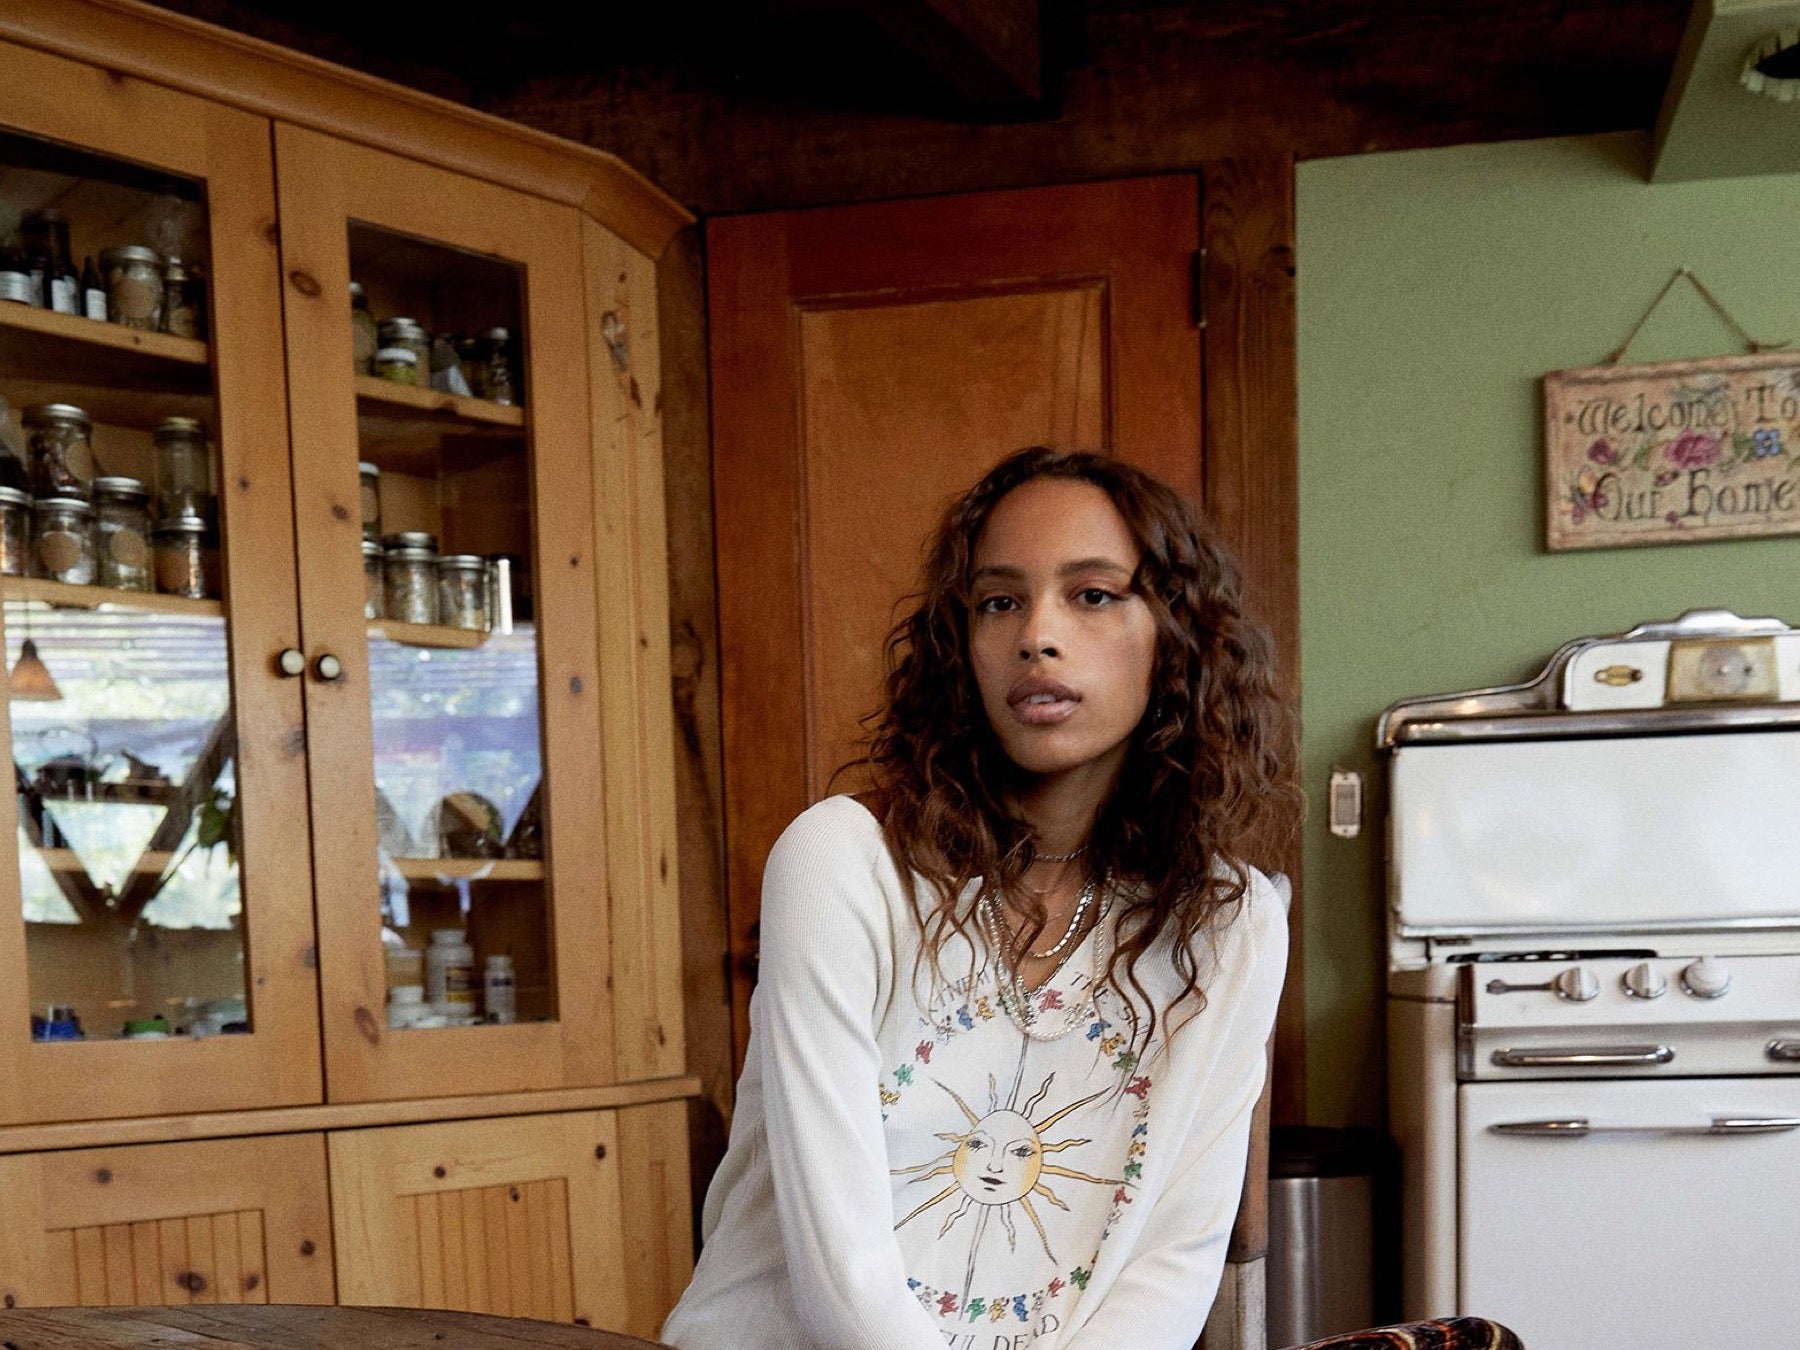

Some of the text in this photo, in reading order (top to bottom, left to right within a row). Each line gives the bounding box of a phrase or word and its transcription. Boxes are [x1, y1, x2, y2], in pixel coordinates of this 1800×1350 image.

[1576, 384, 1798, 435] Welcome To
[1594, 471, 1663, 522] Our
